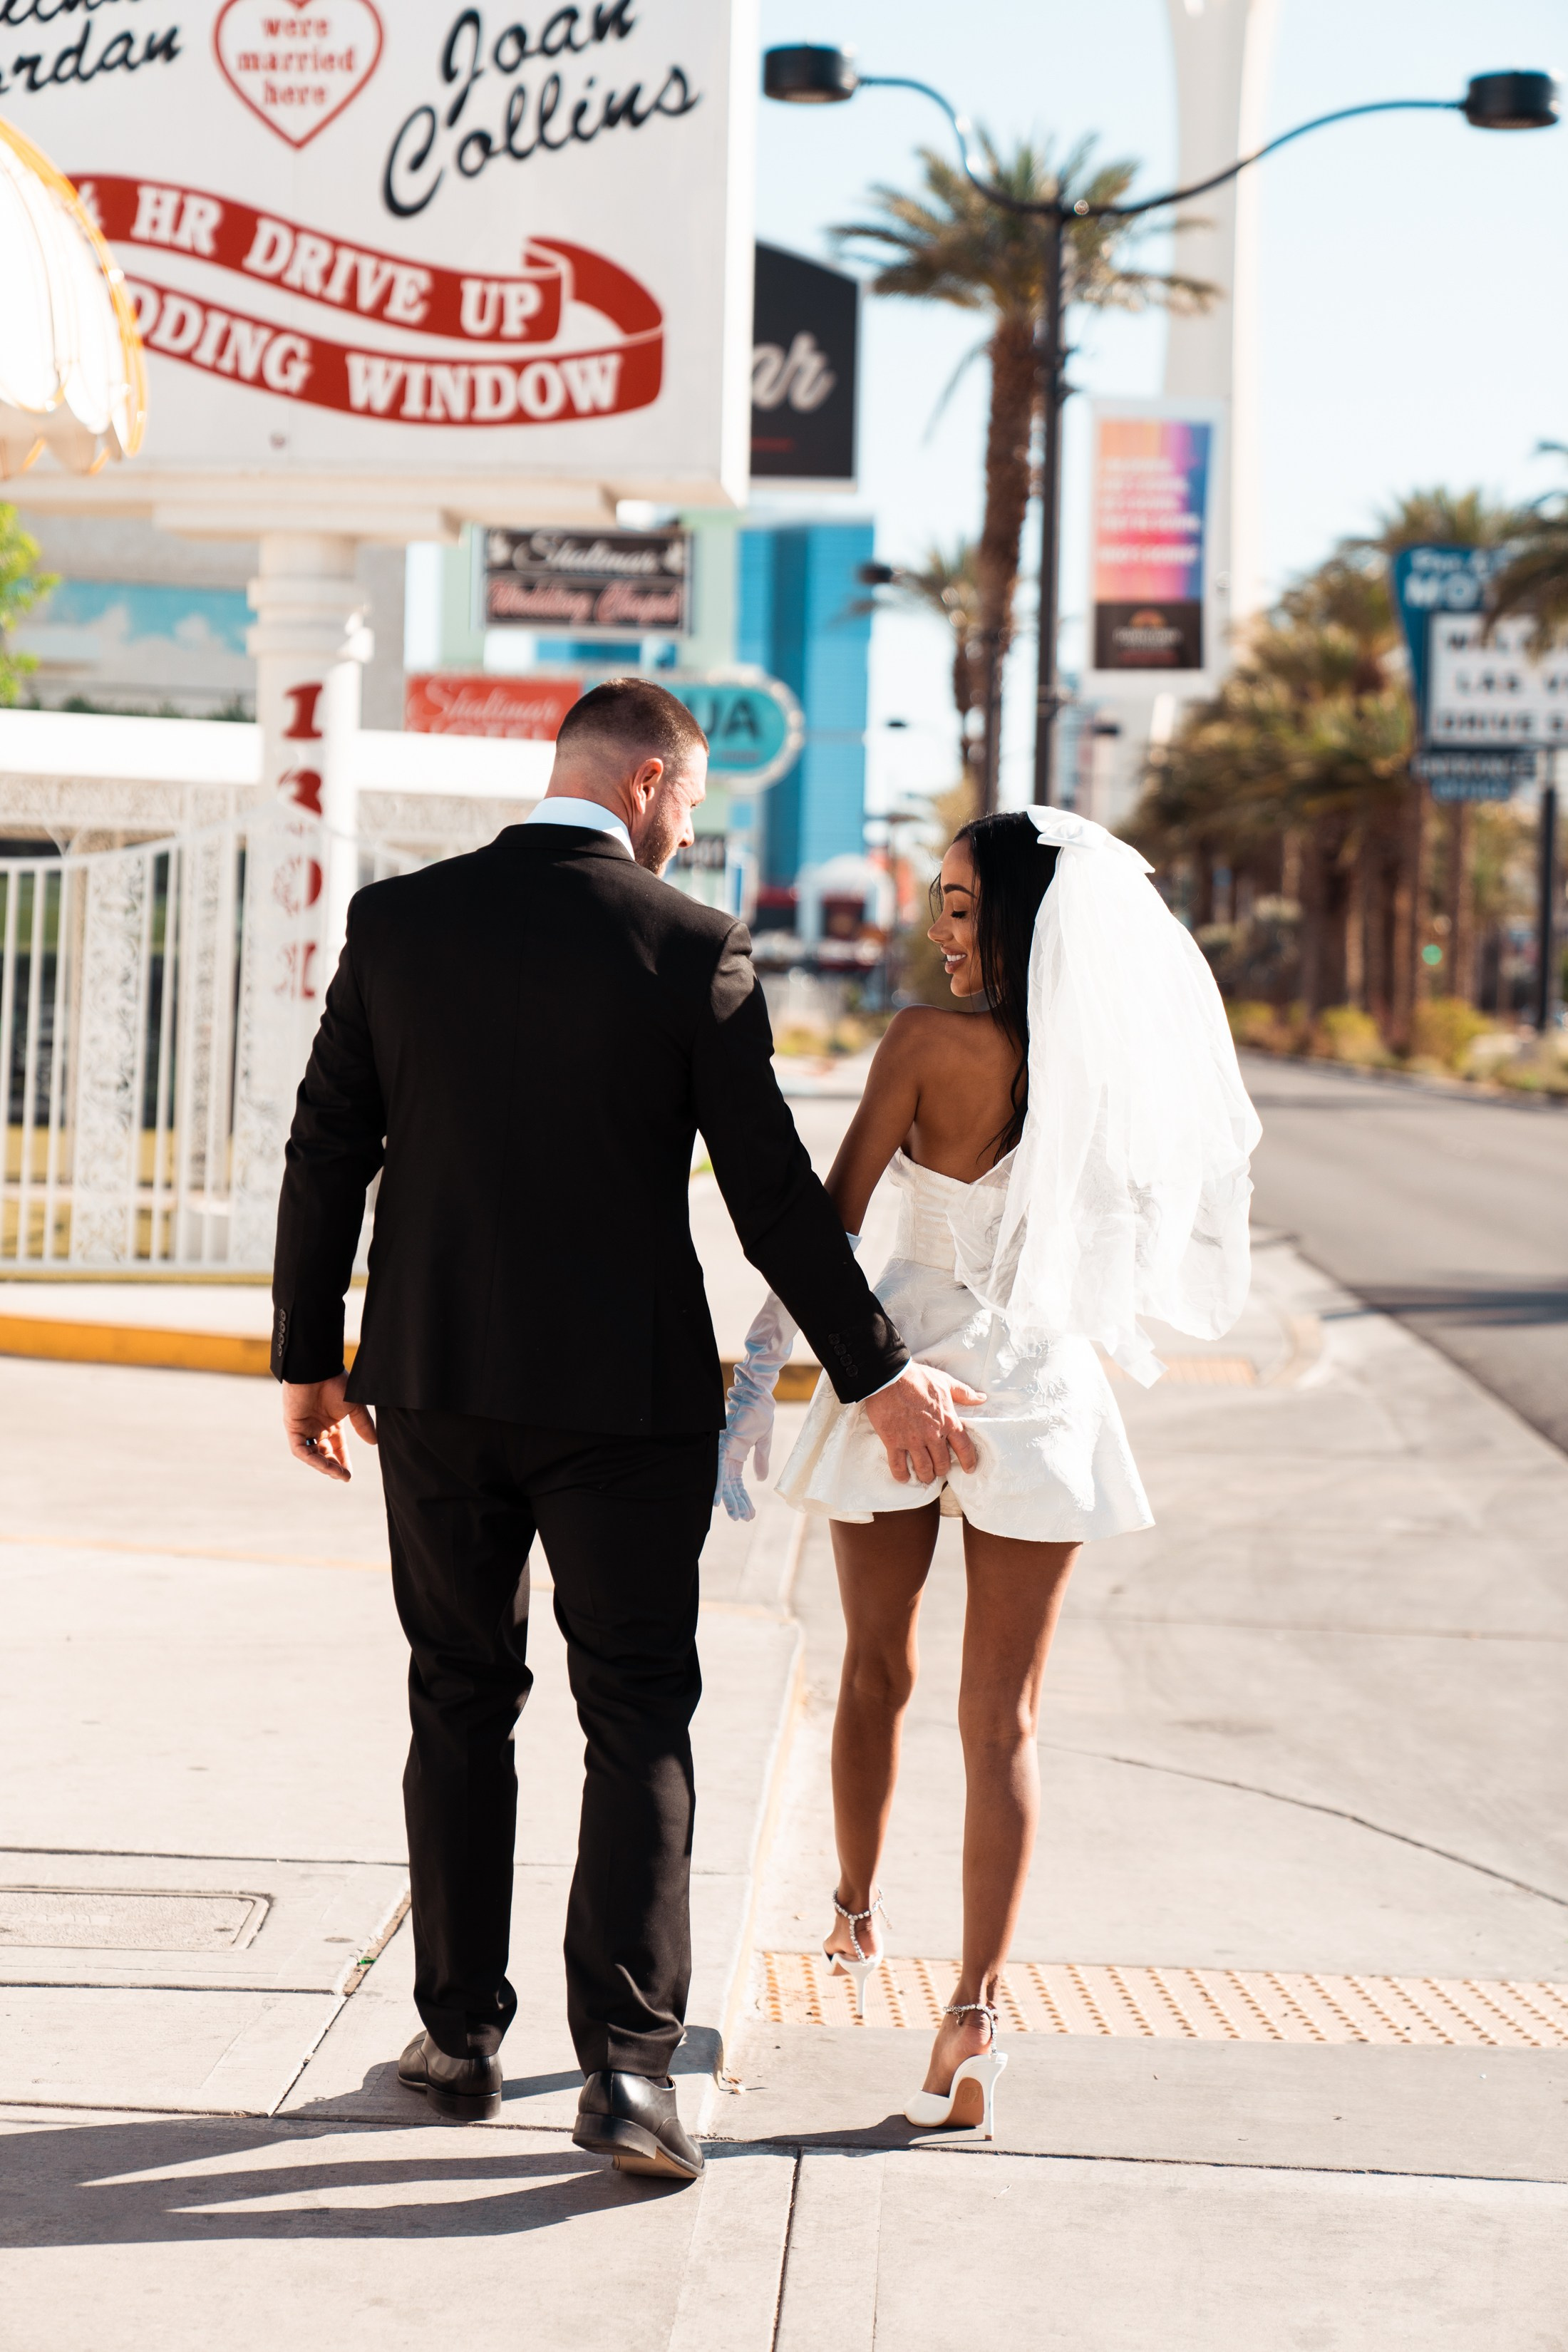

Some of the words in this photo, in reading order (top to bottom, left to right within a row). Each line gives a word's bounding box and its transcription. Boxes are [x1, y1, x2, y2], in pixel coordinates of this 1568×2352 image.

[0, 19, 181, 93] rdan
[237, 45, 354, 72] married
[264, 18, 329, 38] were
[264, 78, 326, 105] here
[442, 0, 636, 128] Joan
[384, 66, 700, 217] Collins
[130, 184, 222, 257] HR
[242, 215, 432, 326] DRIVE
[460, 278, 544, 339] UP
[345, 352, 624, 421] WINDOW
